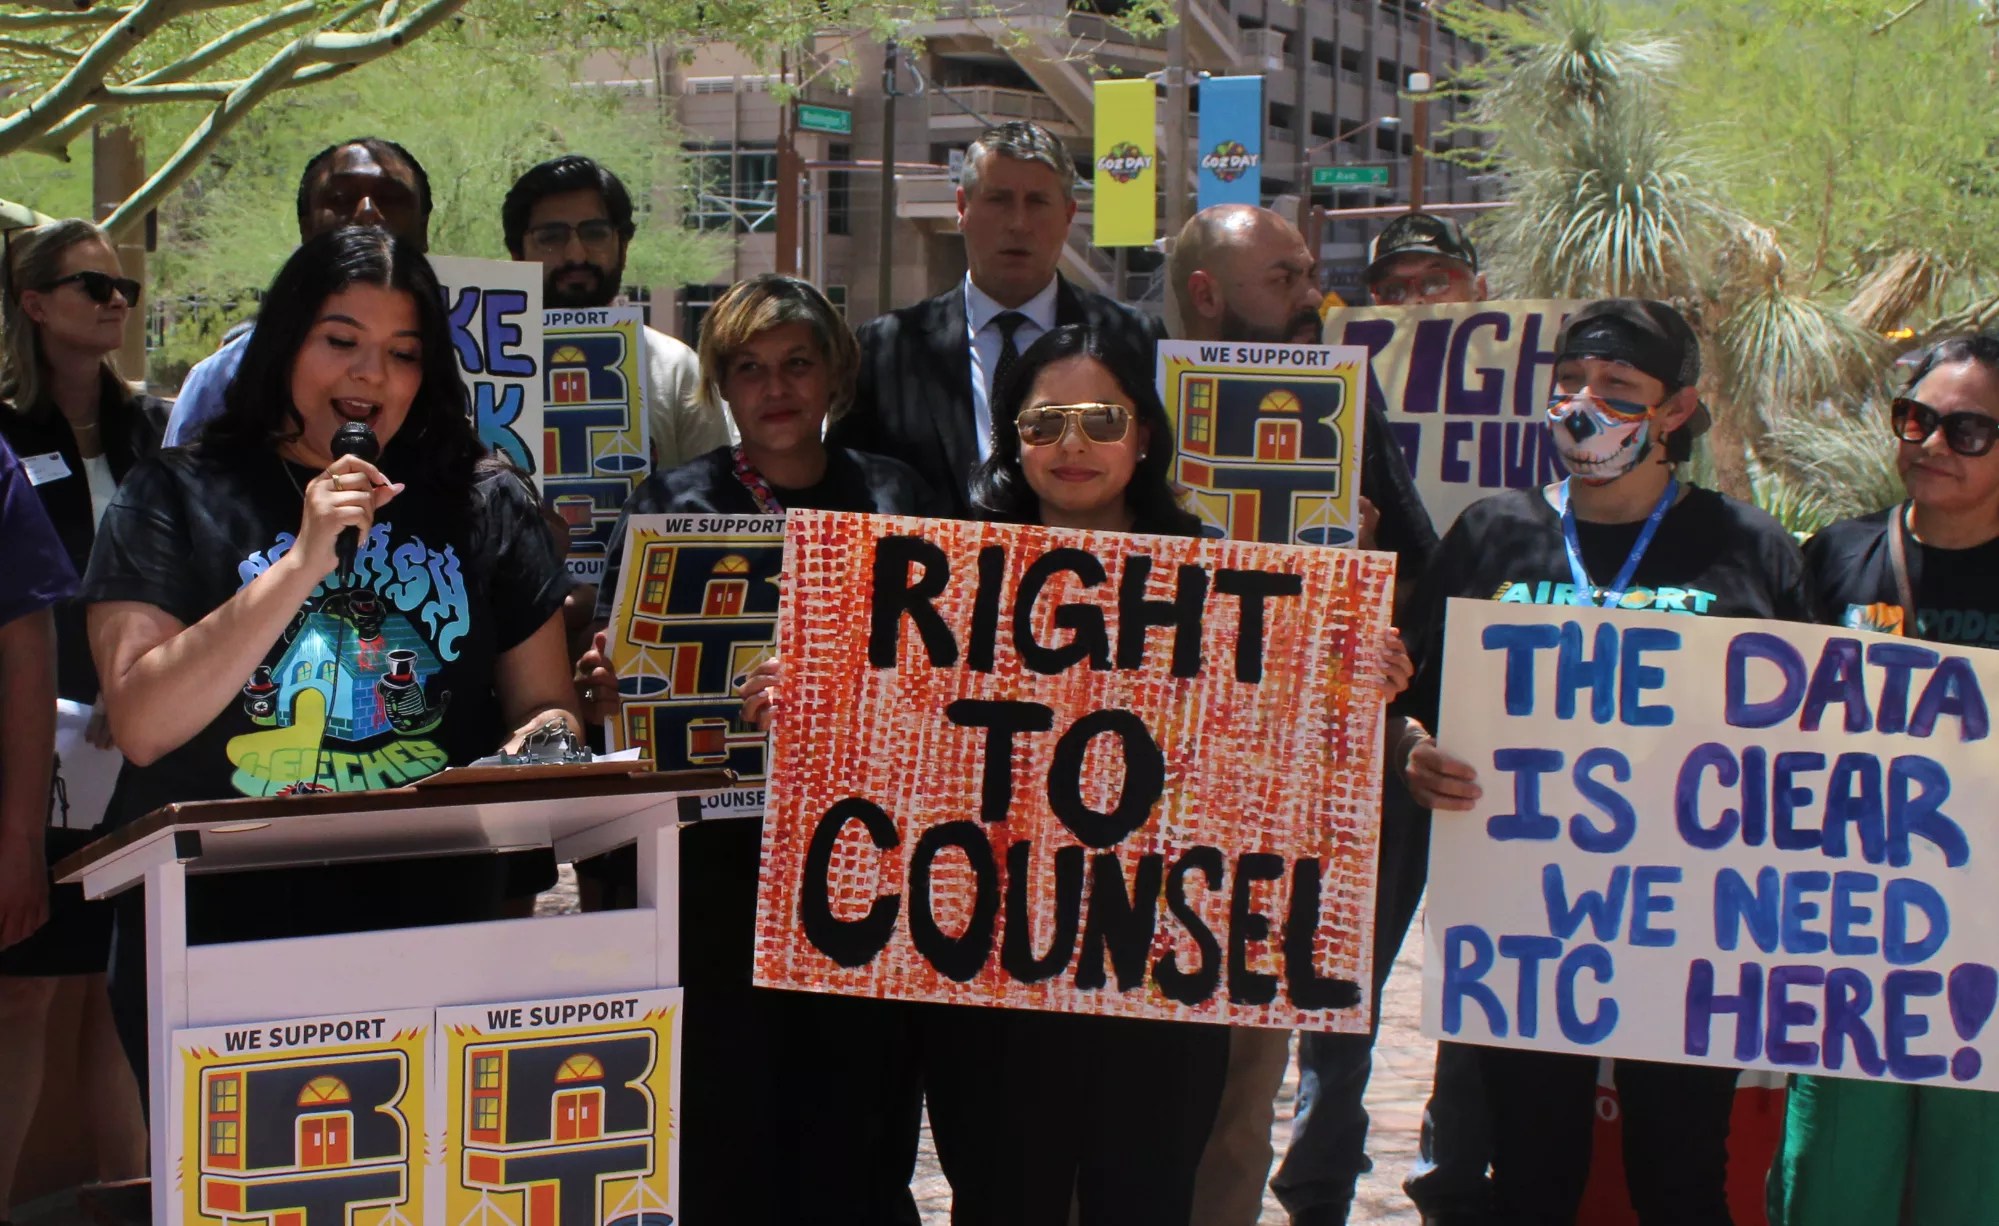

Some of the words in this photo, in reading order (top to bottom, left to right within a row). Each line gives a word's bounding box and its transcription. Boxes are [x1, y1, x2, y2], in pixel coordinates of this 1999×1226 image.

[1124, 155, 1153, 170] DAY
[1229, 153, 1259, 169] DAY
[440, 286, 537, 378] KE
[543, 311, 609, 326] UPPORT
[1200, 346, 1230, 363] WE
[1236, 347, 1331, 366] SUPPORT
[1342, 312, 1570, 416] RIGH
[464, 381, 537, 476] K
[665, 518, 694, 533] WE
[697, 518, 786, 533] SUPPORT
[868, 534, 1302, 684] RIGHT
[1499, 580, 1717, 613] AIRORT
[1481, 620, 1682, 727] THE
[1724, 631, 1990, 743] DATA
[701, 790, 766, 809] OUNSE
[945, 700, 1166, 850] TO
[1487, 747, 1637, 853] IS
[800, 796, 1361, 1010] COUNSEL
[1542, 863, 1683, 948] WE
[1714, 865, 1950, 965] NEED
[225, 1029, 262, 1051] WE
[269, 1018, 386, 1048] SUPPORT
[487, 1008, 522, 1030] WE
[529, 998, 639, 1027] SUPPORT
[1441, 923, 1620, 1046] RTC
[1684, 958, 1999, 1082] HERE!
